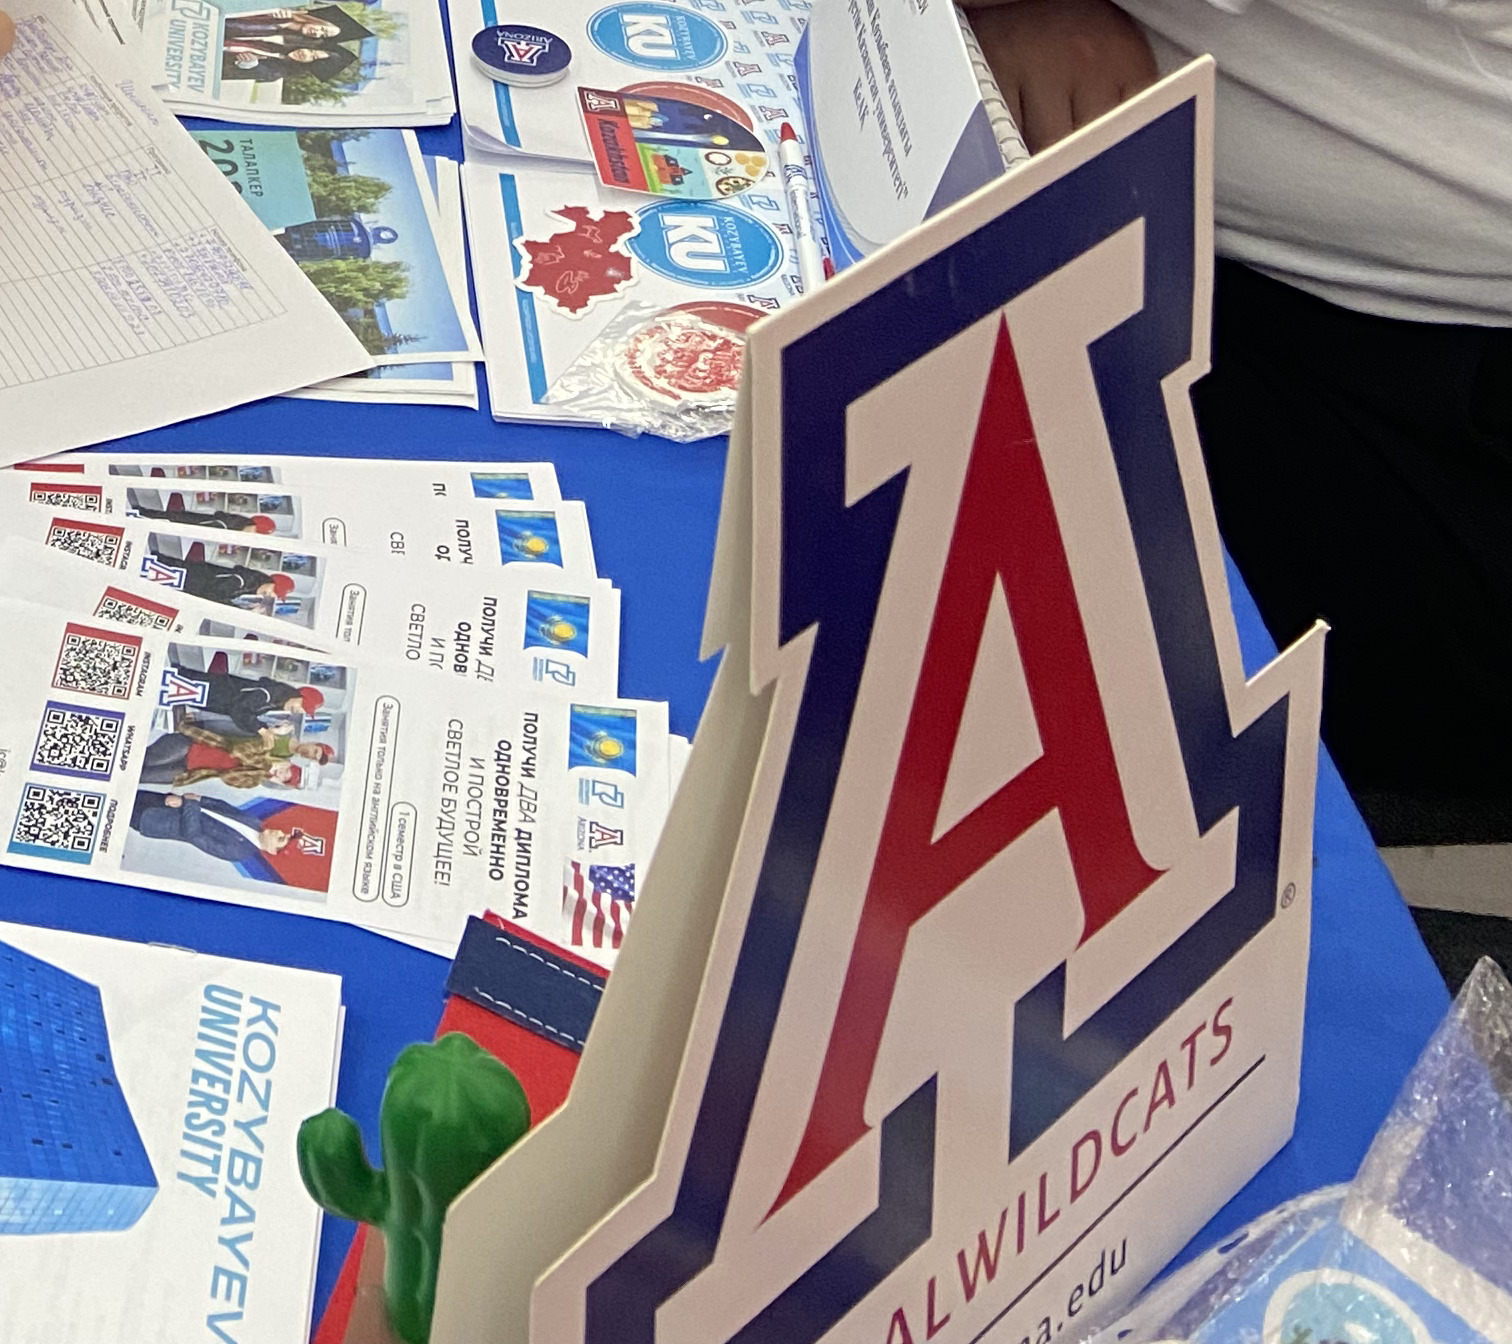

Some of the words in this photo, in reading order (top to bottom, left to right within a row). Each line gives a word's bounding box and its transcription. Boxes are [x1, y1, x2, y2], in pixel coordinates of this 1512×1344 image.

[165, 19, 187, 89] UNIVERSITY
[188, 22, 210, 93] KOZYBAYEV
[497, 29, 553, 44] ARIZONA
[617, 11, 683, 62] KU
[239, 138, 263, 197] ТАЛАПКЕР
[658, 213, 730, 273] KU
[724, 216, 748, 274] KOZYBAYEV
[406, 604, 425, 660] СВЕТЛО
[479, 597, 497, 656] ПОЛУЧИ
[136, 651, 151, 698] INSTAGRAM
[119, 724, 136, 772] WHATSAPP
[377, 702, 394, 747] Занятия
[521, 712, 539, 779] ПОЛУЧИ
[441, 718, 463, 793] СВЕТЛОЕ
[470, 756, 486, 770] И
[99, 798, 118, 853] ПОДРОБНЕЕ
[463, 779, 484, 857] ПОСТРОЙ
[488, 739, 512, 881] ОДНОВРЕМЕННО
[517, 781, 539, 824] ДВА
[392, 818, 409, 861] семестр
[433, 797, 458, 887] БУДУЩЕЕ!
[389, 872, 405, 900] США
[512, 827, 532, 920] ДИПЛОМА
[175, 984, 244, 1199] UNIVERSITY
[207, 994, 282, 1344] KOZYBAYEV
